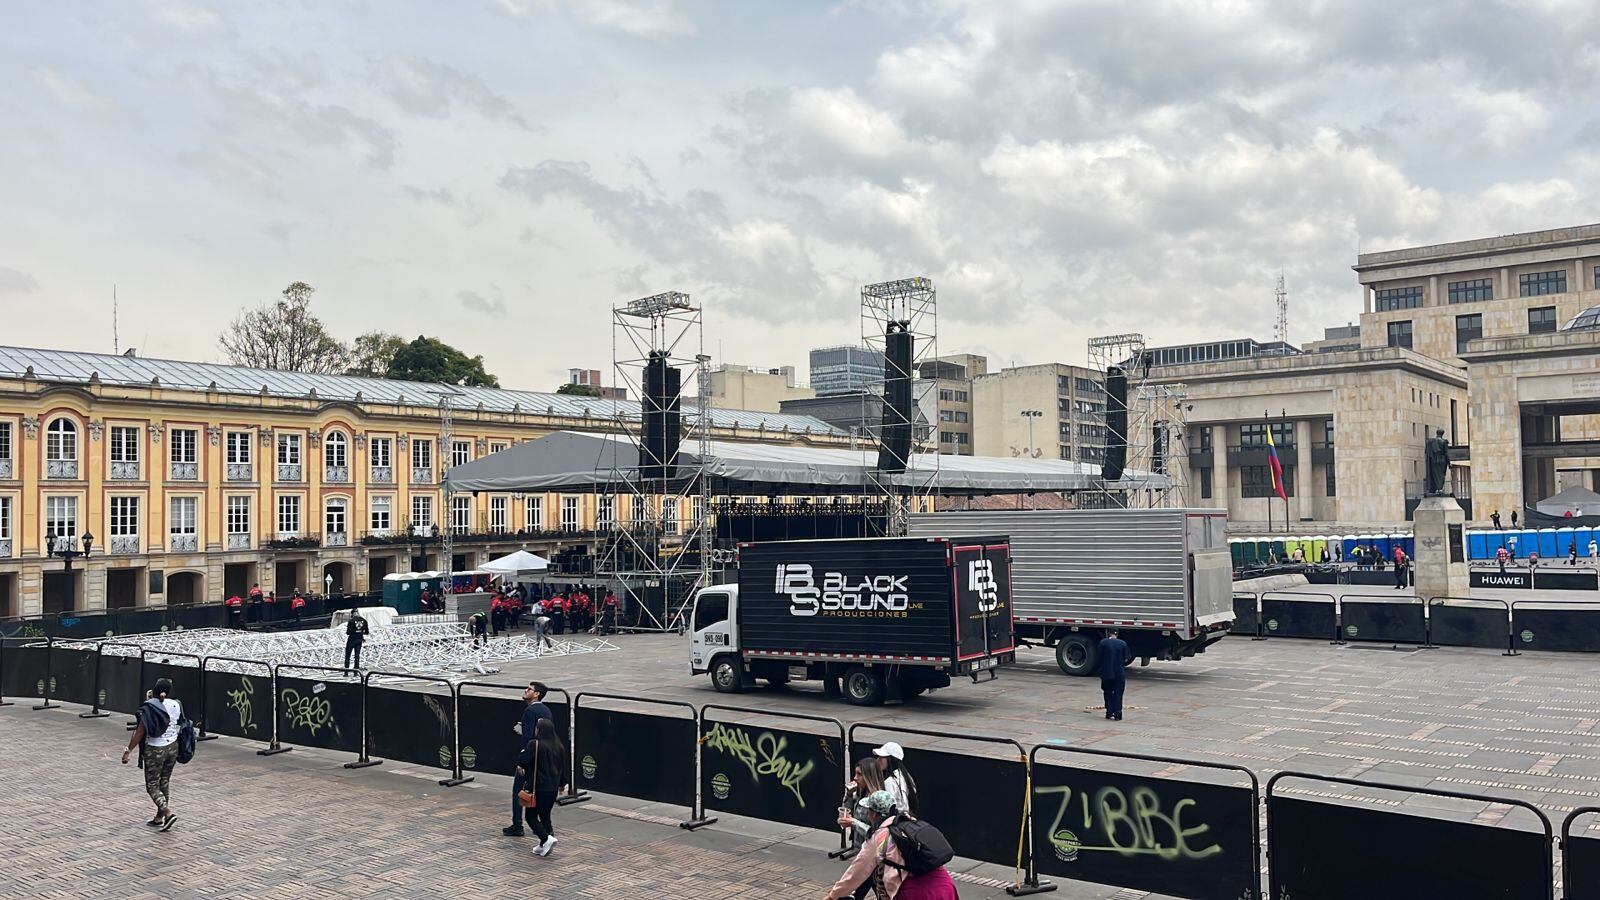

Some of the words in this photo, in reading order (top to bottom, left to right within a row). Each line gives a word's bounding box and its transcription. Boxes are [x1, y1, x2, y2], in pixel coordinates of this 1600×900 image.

[823, 572, 908, 592] BLACK
[1481, 576, 1524, 585] HUAWEI
[822, 591, 909, 611] SOUND
